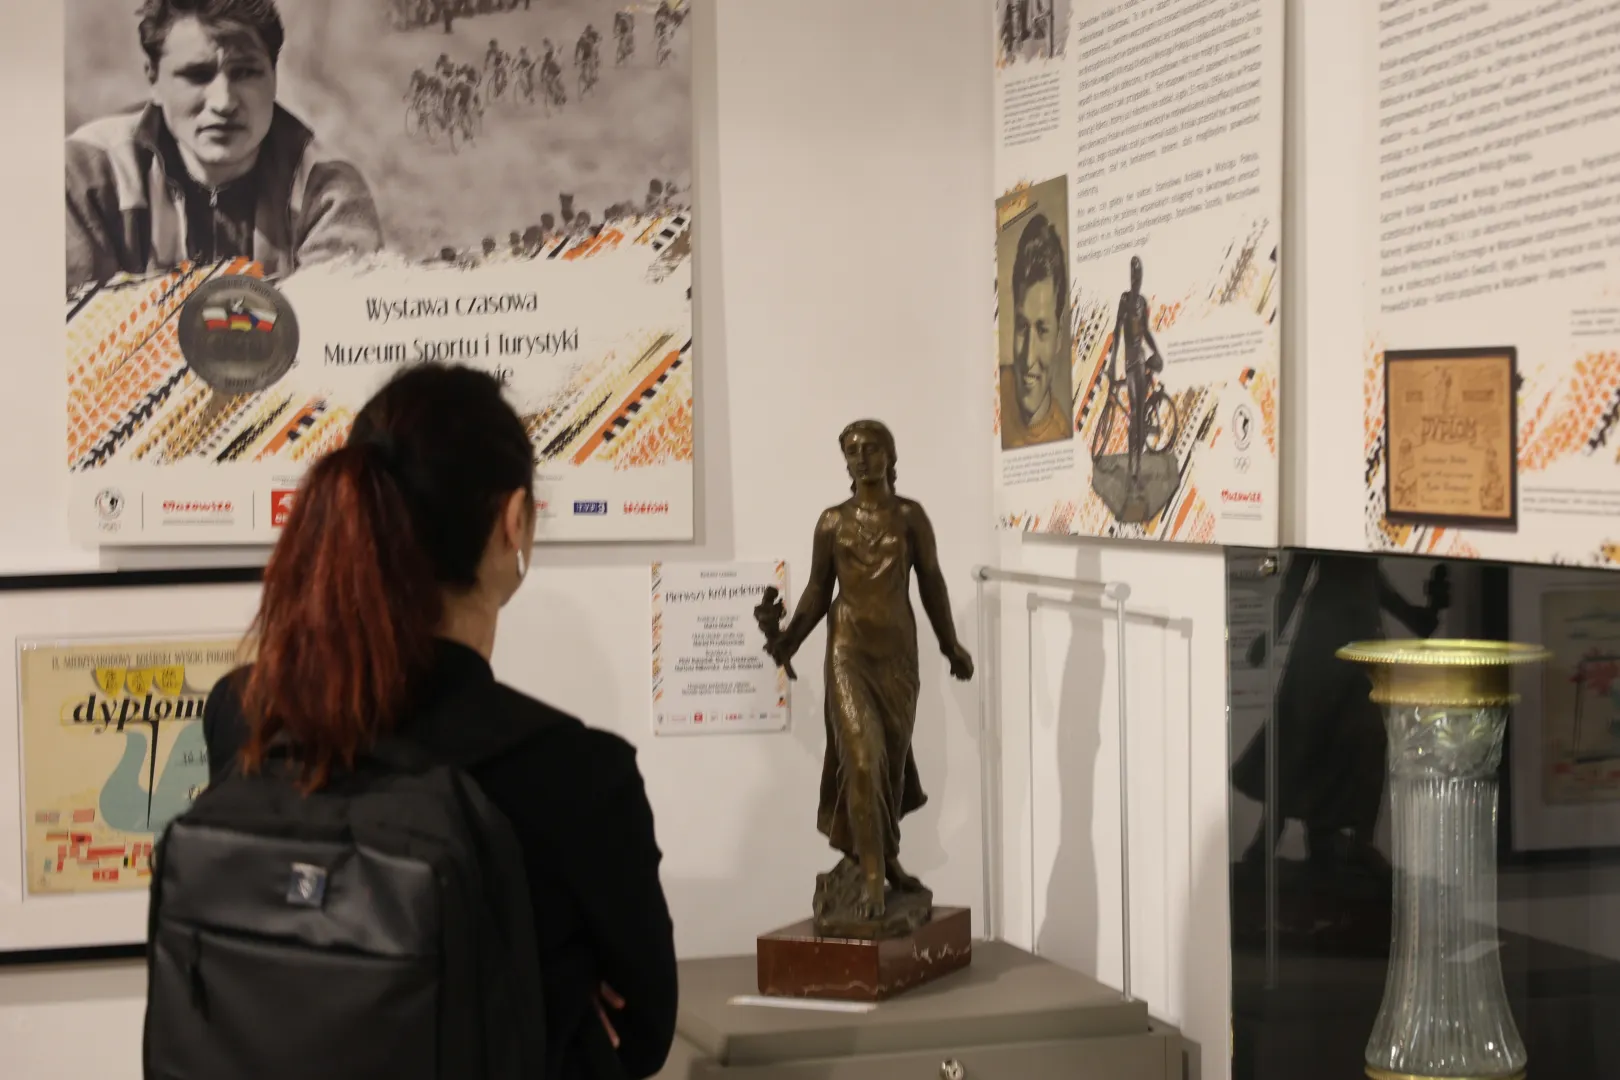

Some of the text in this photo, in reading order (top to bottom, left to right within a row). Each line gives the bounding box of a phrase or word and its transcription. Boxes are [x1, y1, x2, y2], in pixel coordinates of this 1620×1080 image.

[367, 292, 537, 325] Wystawa czasowa
[324, 327, 579, 366] Muzeum Sportu i Turystyki
[665, 589, 706, 605] Pierwszy
[708, 585, 727, 600] król
[73, 693, 204, 733] dyplom
